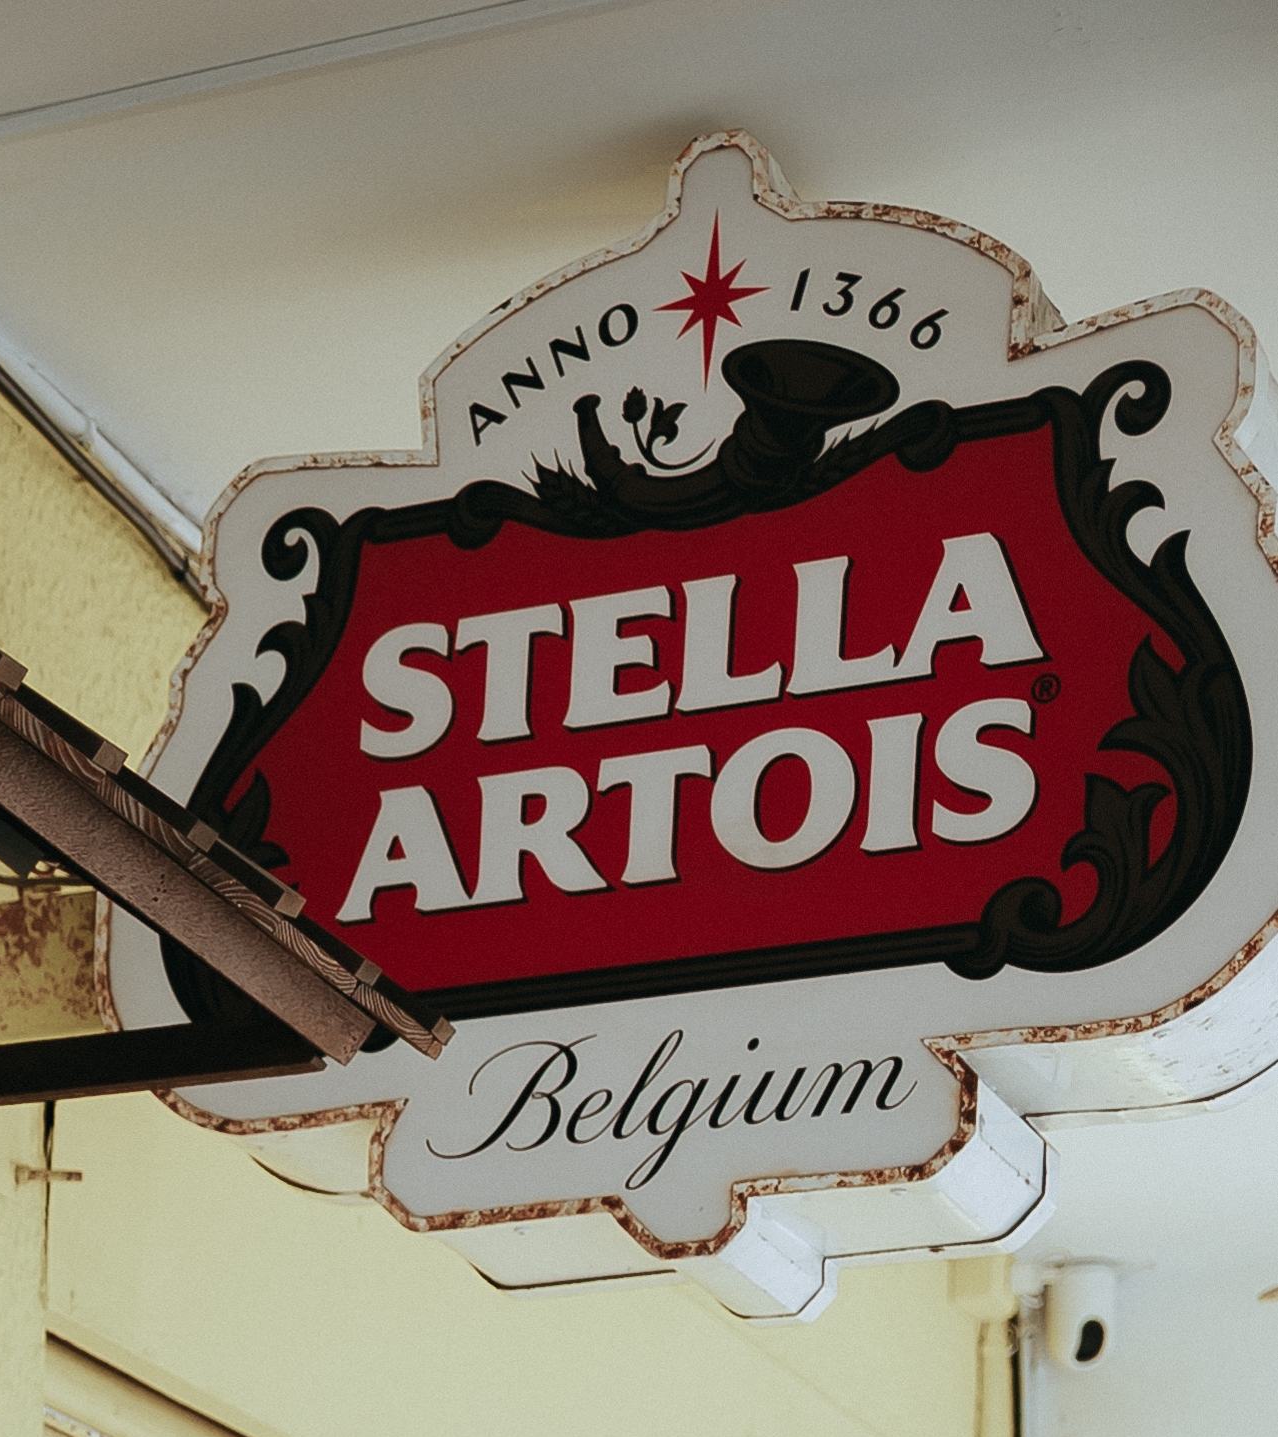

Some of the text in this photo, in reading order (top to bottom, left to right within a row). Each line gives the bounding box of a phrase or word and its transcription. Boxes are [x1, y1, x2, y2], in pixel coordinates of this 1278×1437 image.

[467, 267, 951, 446] ANNO 1366
[359, 531, 1047, 763] STELLA
[336, 697, 1041, 926] ARTOIS
[427, 1030, 917, 1190] Belgium
